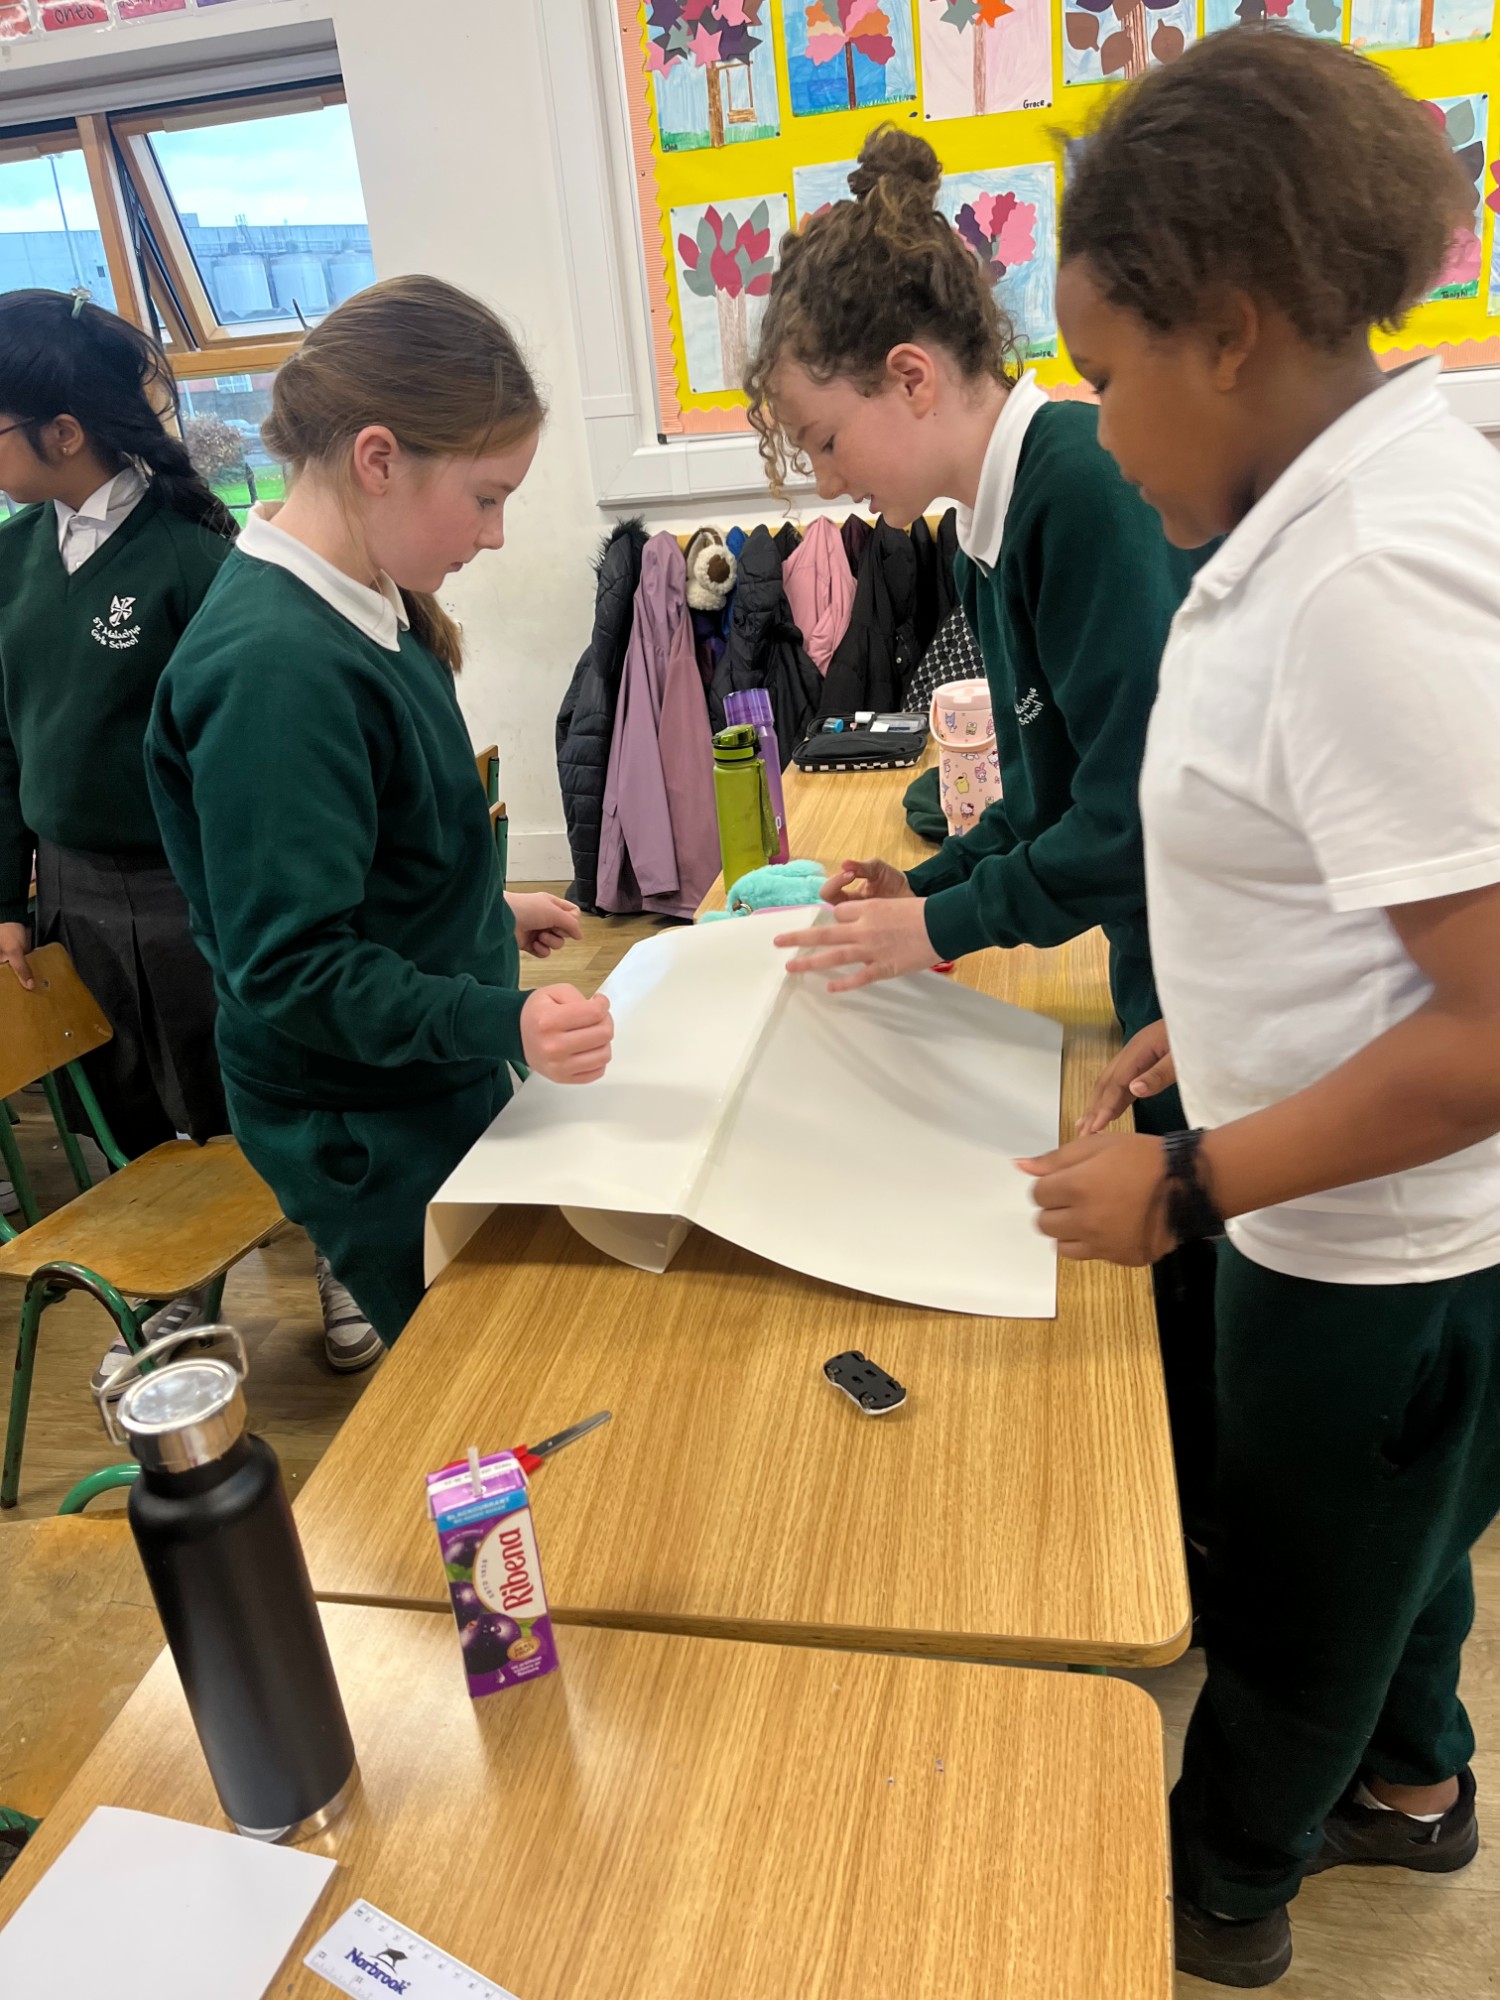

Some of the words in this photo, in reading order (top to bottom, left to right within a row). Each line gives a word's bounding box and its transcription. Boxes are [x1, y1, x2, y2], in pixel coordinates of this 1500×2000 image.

[54, 4, 95, 24] ones
[109, 635, 139, 649] School
[499, 1528, 534, 1612] Ribena
[344, 1946, 409, 1995] Norbrook
